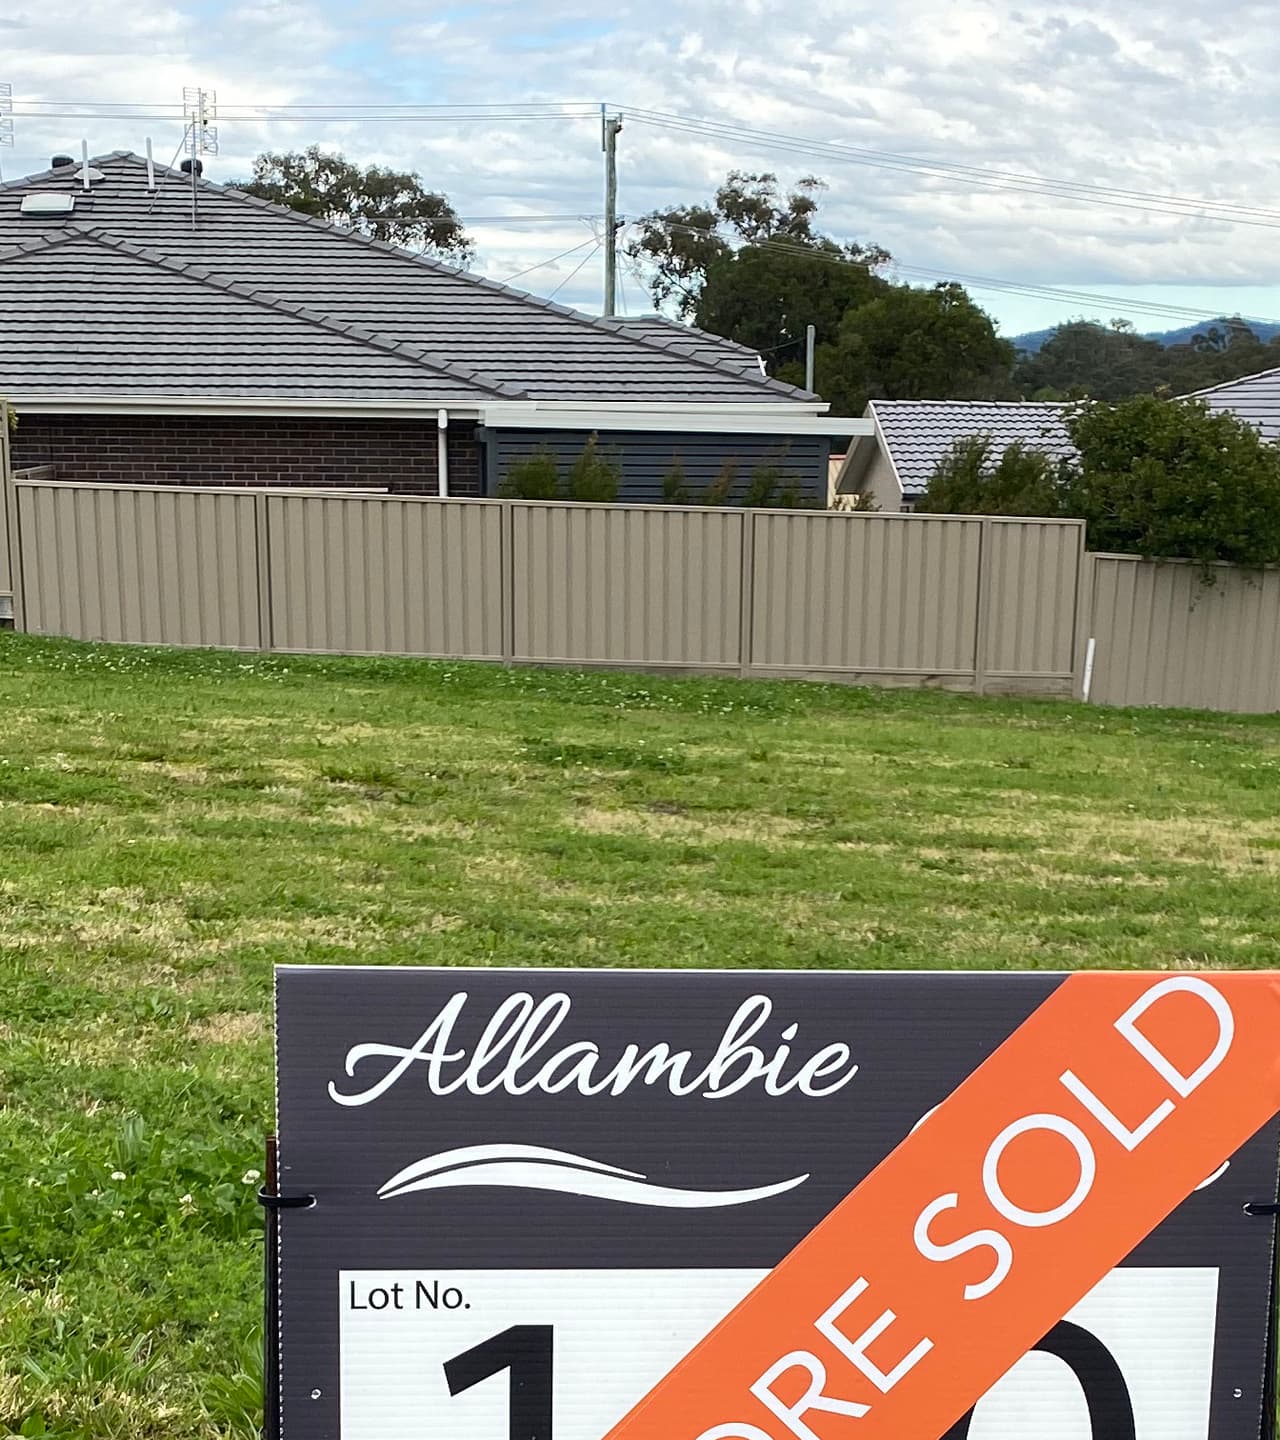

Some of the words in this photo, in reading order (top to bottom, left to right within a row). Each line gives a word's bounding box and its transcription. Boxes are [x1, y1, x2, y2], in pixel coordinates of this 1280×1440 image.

[327, 991, 859, 1107] Allambie
[912, 974, 1236, 1301] SOLD
[349, 1279, 404, 1310] Lot
[414, 1279, 472, 1310] No.
